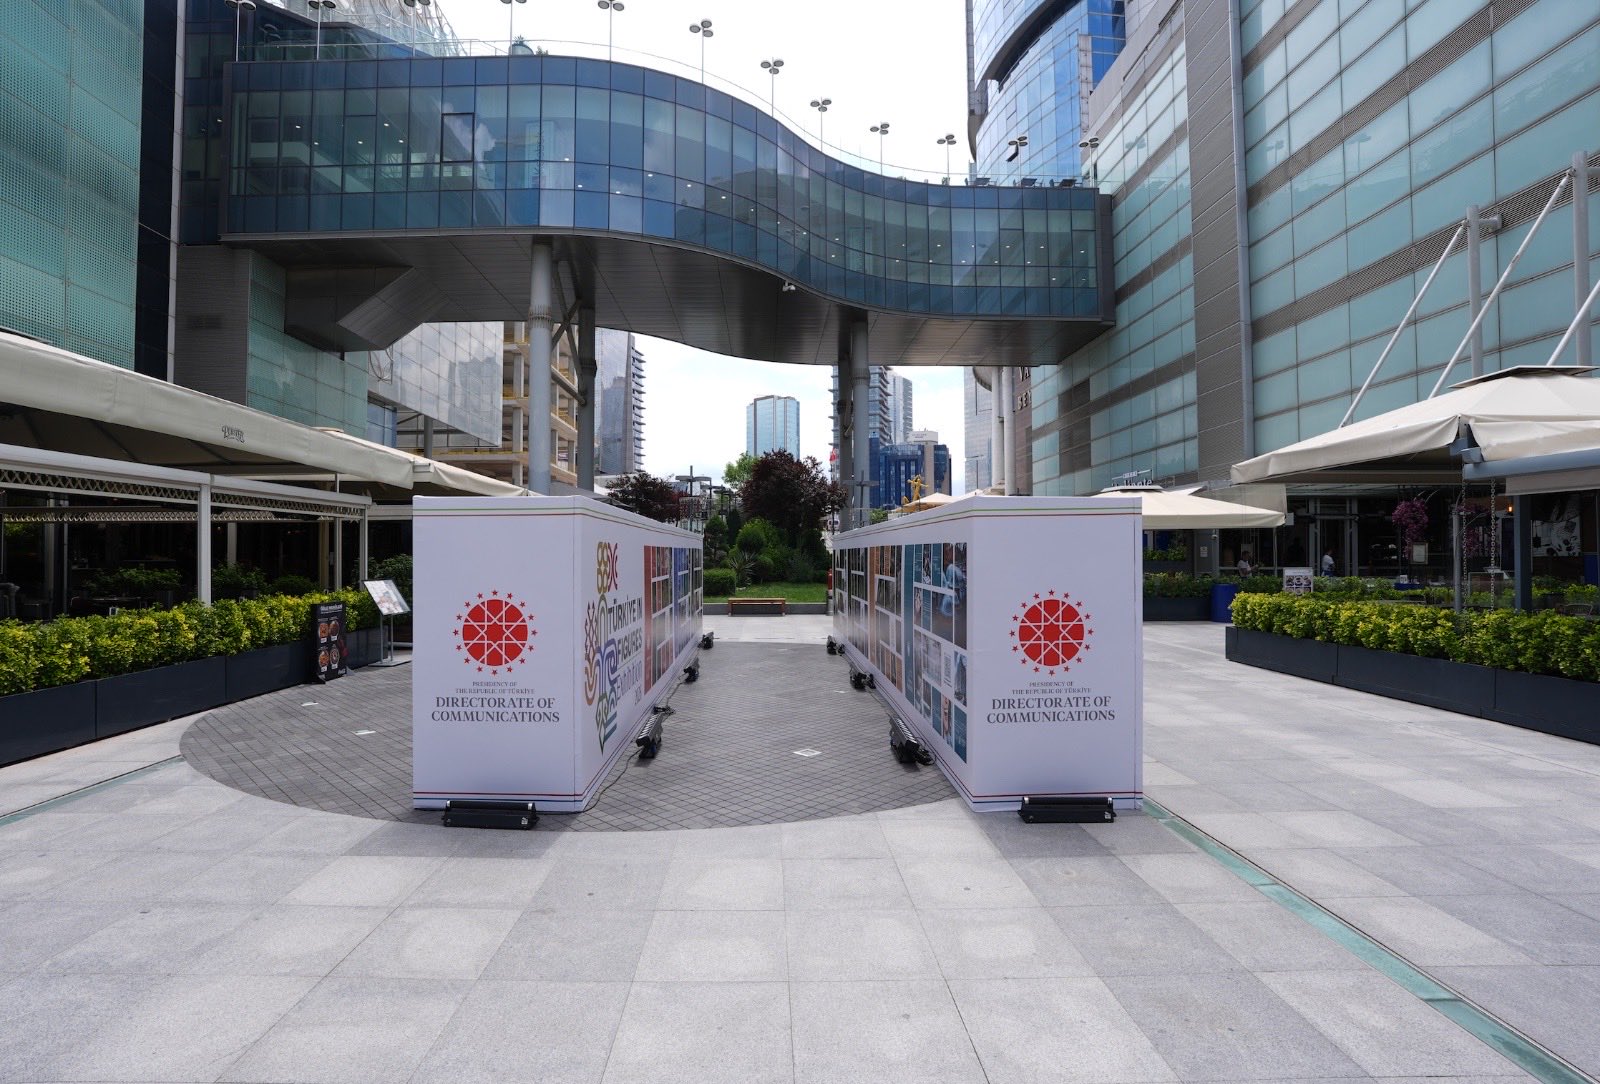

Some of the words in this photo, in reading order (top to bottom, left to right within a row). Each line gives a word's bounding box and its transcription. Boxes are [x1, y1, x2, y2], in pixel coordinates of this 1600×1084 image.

[608, 595, 636, 635] TÜRKİYE
[617, 627, 643, 666] FIGURES
[436, 696, 534, 709] DIRECTORATE
[537, 697, 556, 709] OF
[991, 696, 1090, 710] DIRECTORATE
[1093, 695, 1112, 708] OF
[431, 710, 560, 723] COMMUNICATIONS
[986, 710, 1116, 724] COMMUNICATIONS
